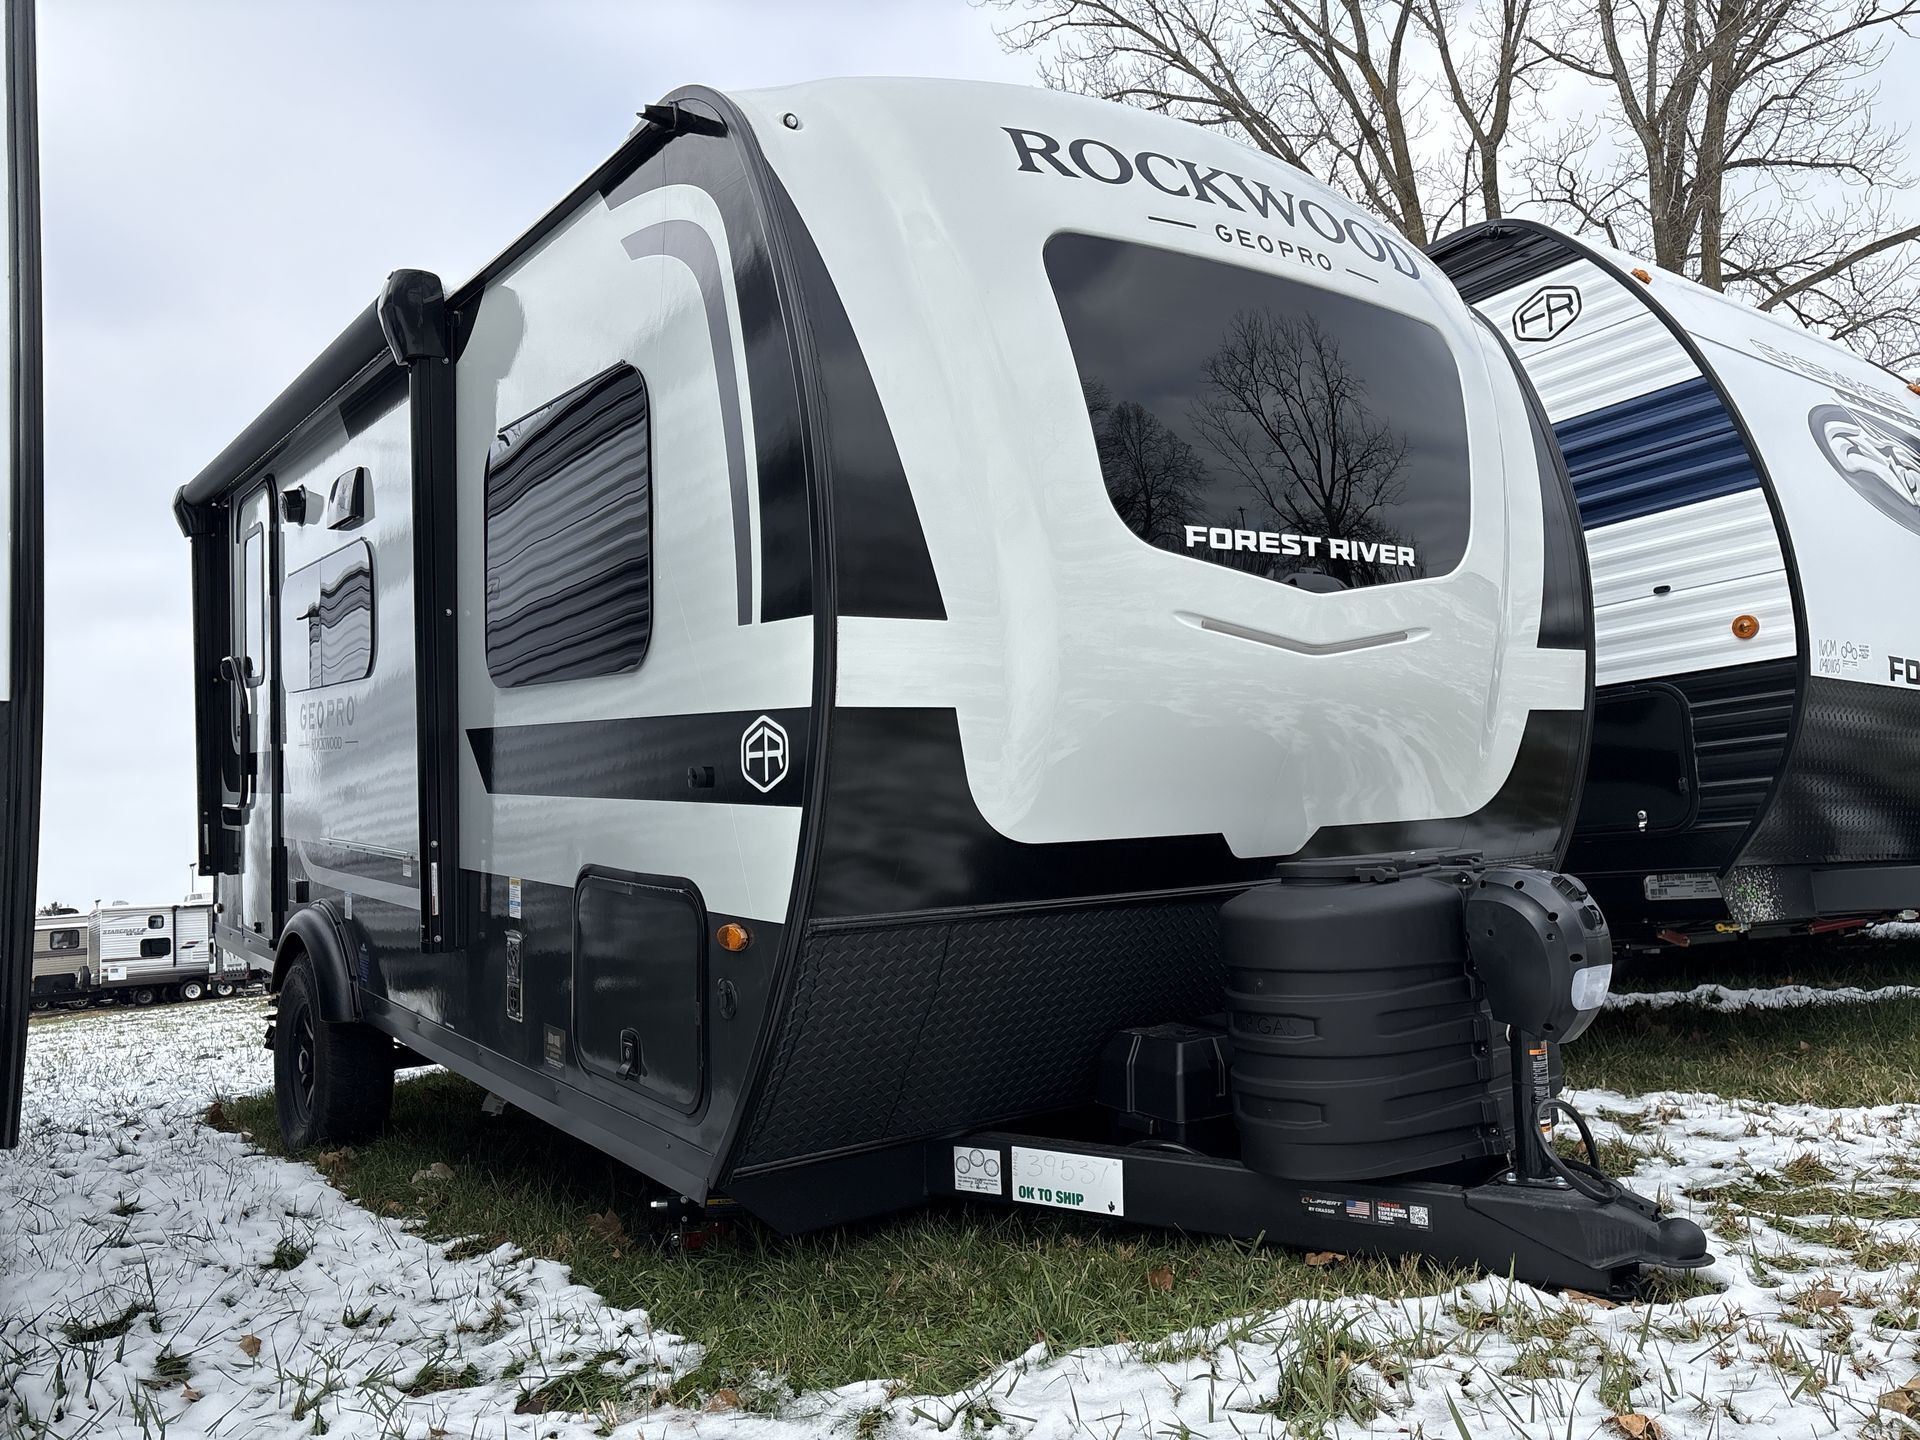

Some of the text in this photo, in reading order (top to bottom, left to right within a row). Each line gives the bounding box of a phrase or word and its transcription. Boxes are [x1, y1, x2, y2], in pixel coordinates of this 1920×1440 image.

[1000, 126, 1420, 281] ROCKWOOD
[1215, 224, 1332, 271] GEOPRO
[1184, 524, 1416, 567] FOREST RIVER
[300, 696, 355, 730] GEOPRO
[745, 726, 784, 783] FR
[1018, 1185, 1084, 1206] OK TO SHIP
